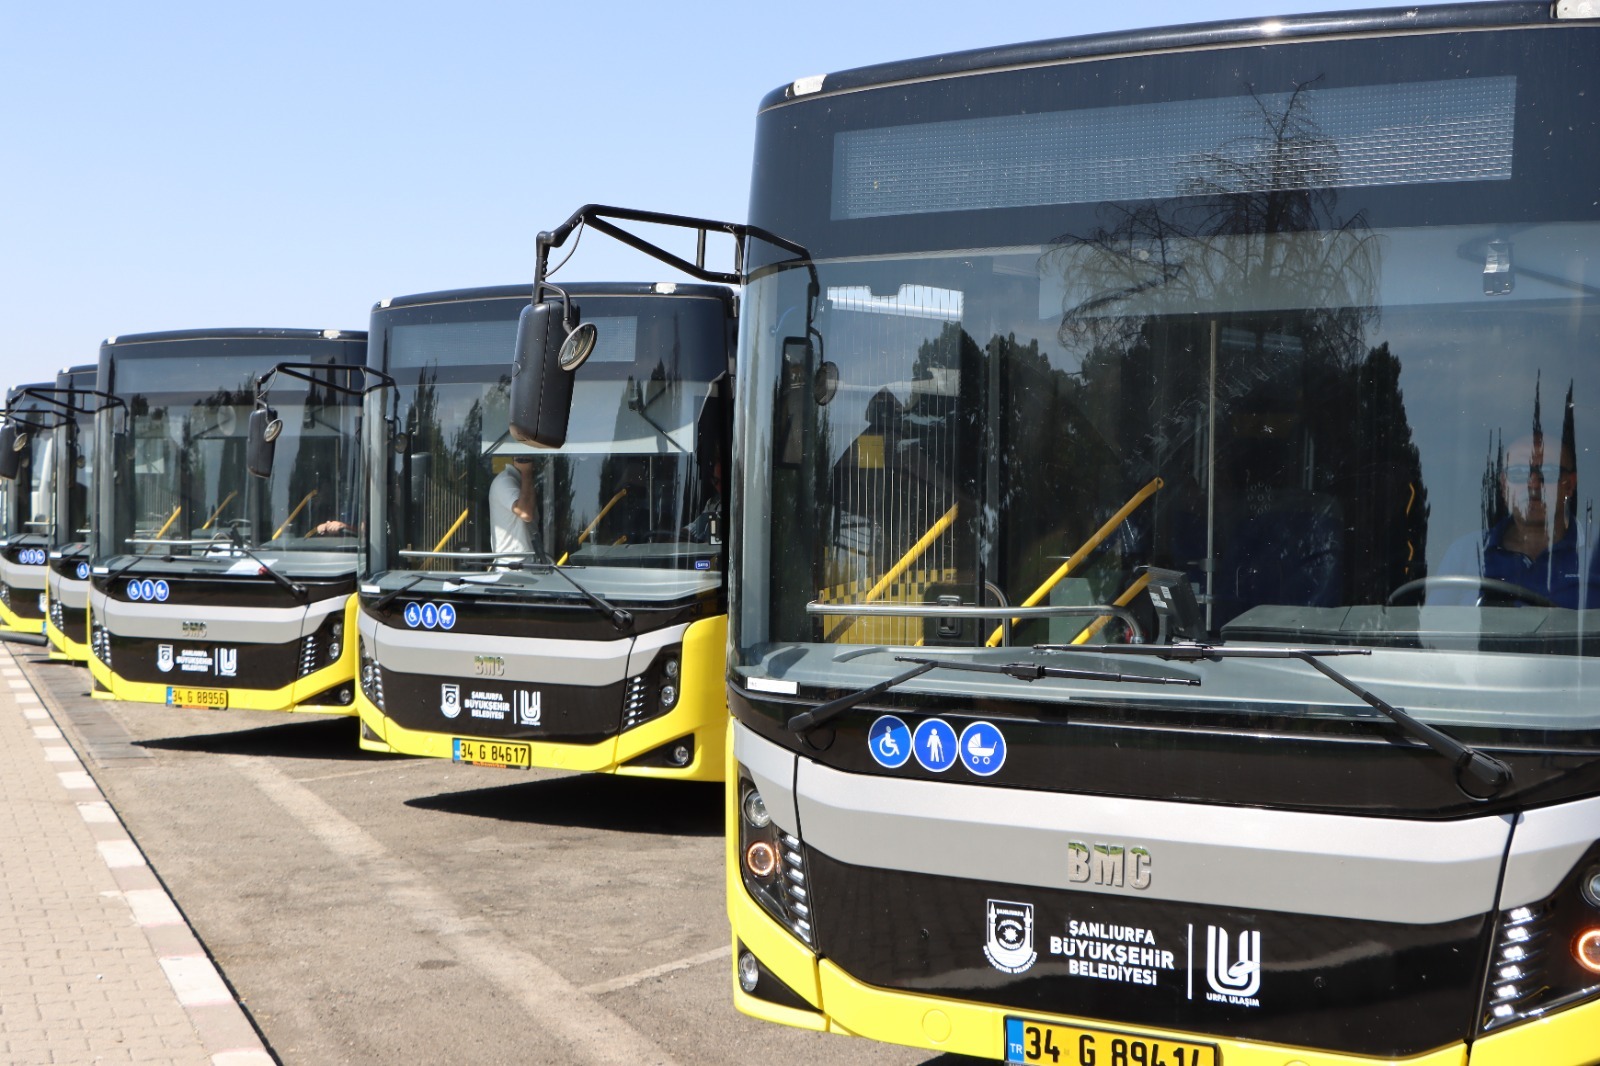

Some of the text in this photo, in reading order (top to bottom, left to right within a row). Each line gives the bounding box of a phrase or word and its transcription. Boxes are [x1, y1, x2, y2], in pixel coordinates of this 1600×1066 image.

[474, 655, 505, 677] BMC
[188, 690, 192, 703] G
[460, 743, 526, 763] 34 G 84617
[1067, 840, 1152, 890] BMC
[1069, 920, 1156, 945] ŞANLIURFA
[1050, 936, 1174, 970] BÜYÜKŞEHİR
[1068, 959, 1157, 986] BELEDİYESİ
[1206, 992, 1260, 1007] URFA ULAŞIM
[1010, 1042, 1023, 1054] TR
[1026, 1026, 1060, 1063] 34
[1079, 1034, 1096, 1066] G
